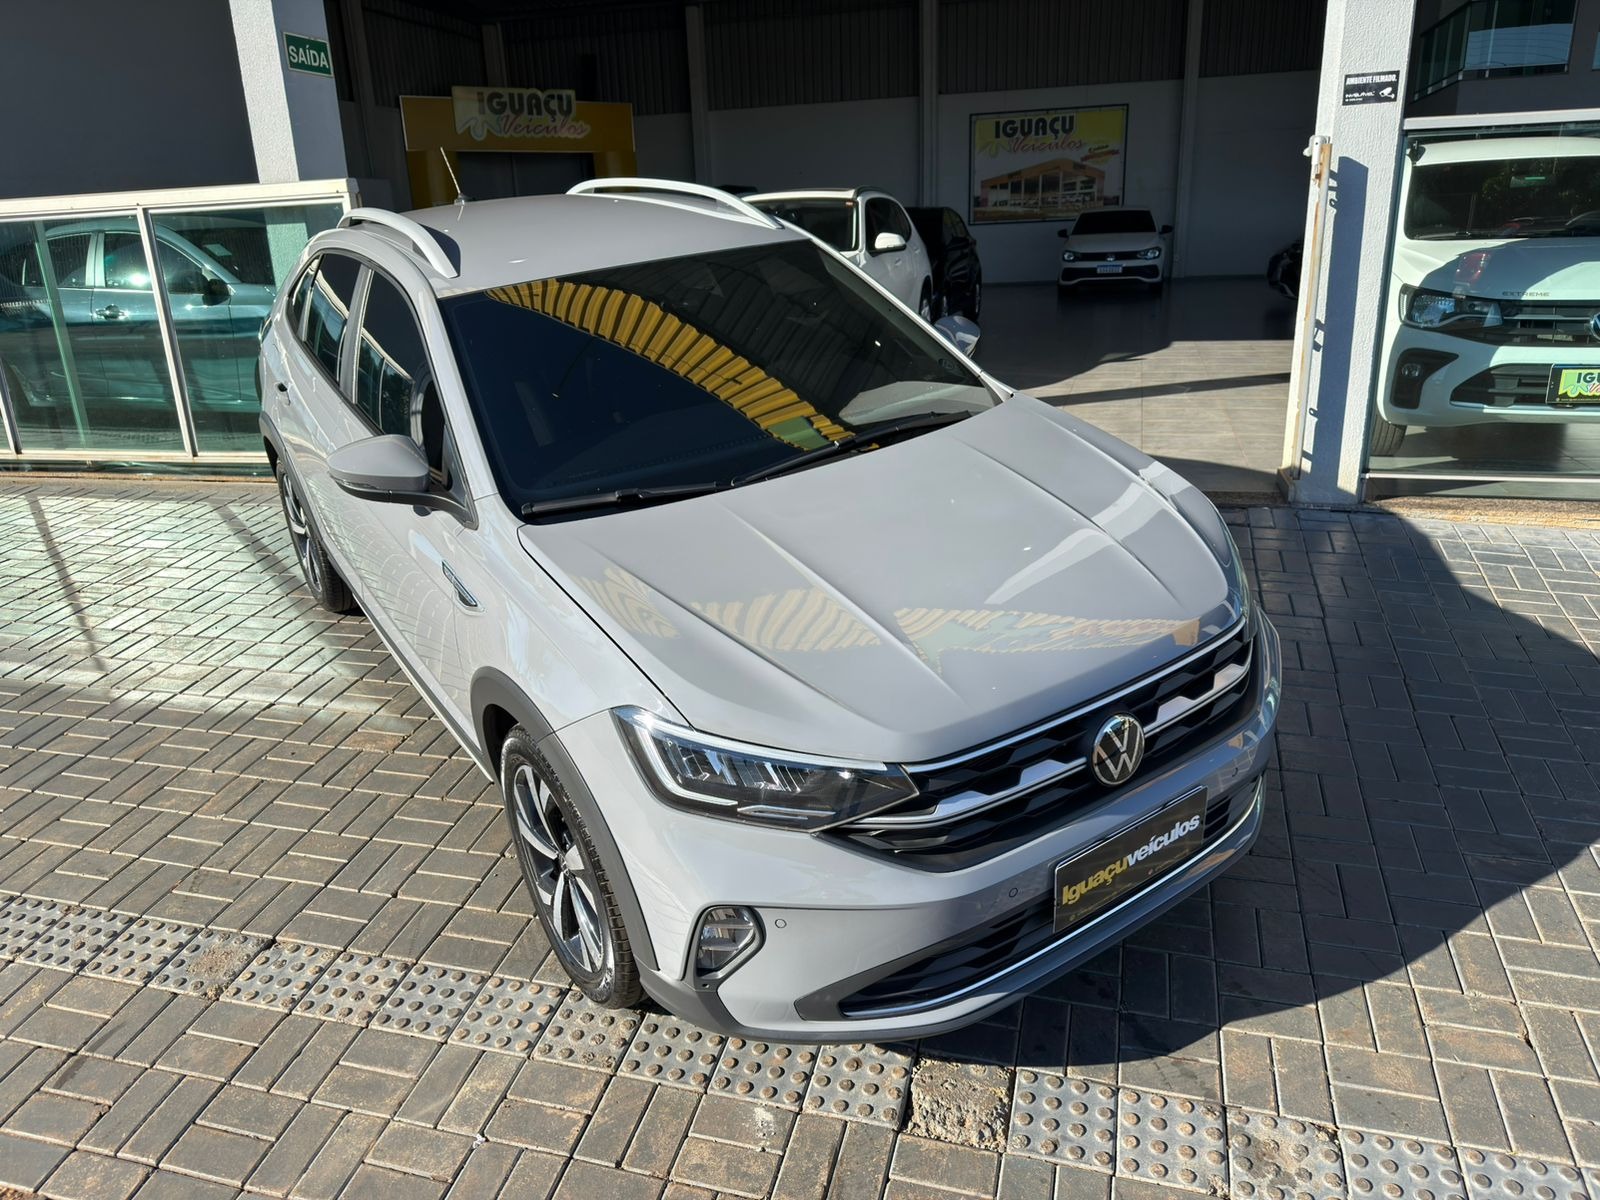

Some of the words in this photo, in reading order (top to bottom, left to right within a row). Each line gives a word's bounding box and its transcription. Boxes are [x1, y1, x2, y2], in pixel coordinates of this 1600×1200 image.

[289, 45, 329, 69] SAÍDA
[477, 91, 573, 121] IGUAÇU
[994, 115, 1075, 140] IGUAÇU
